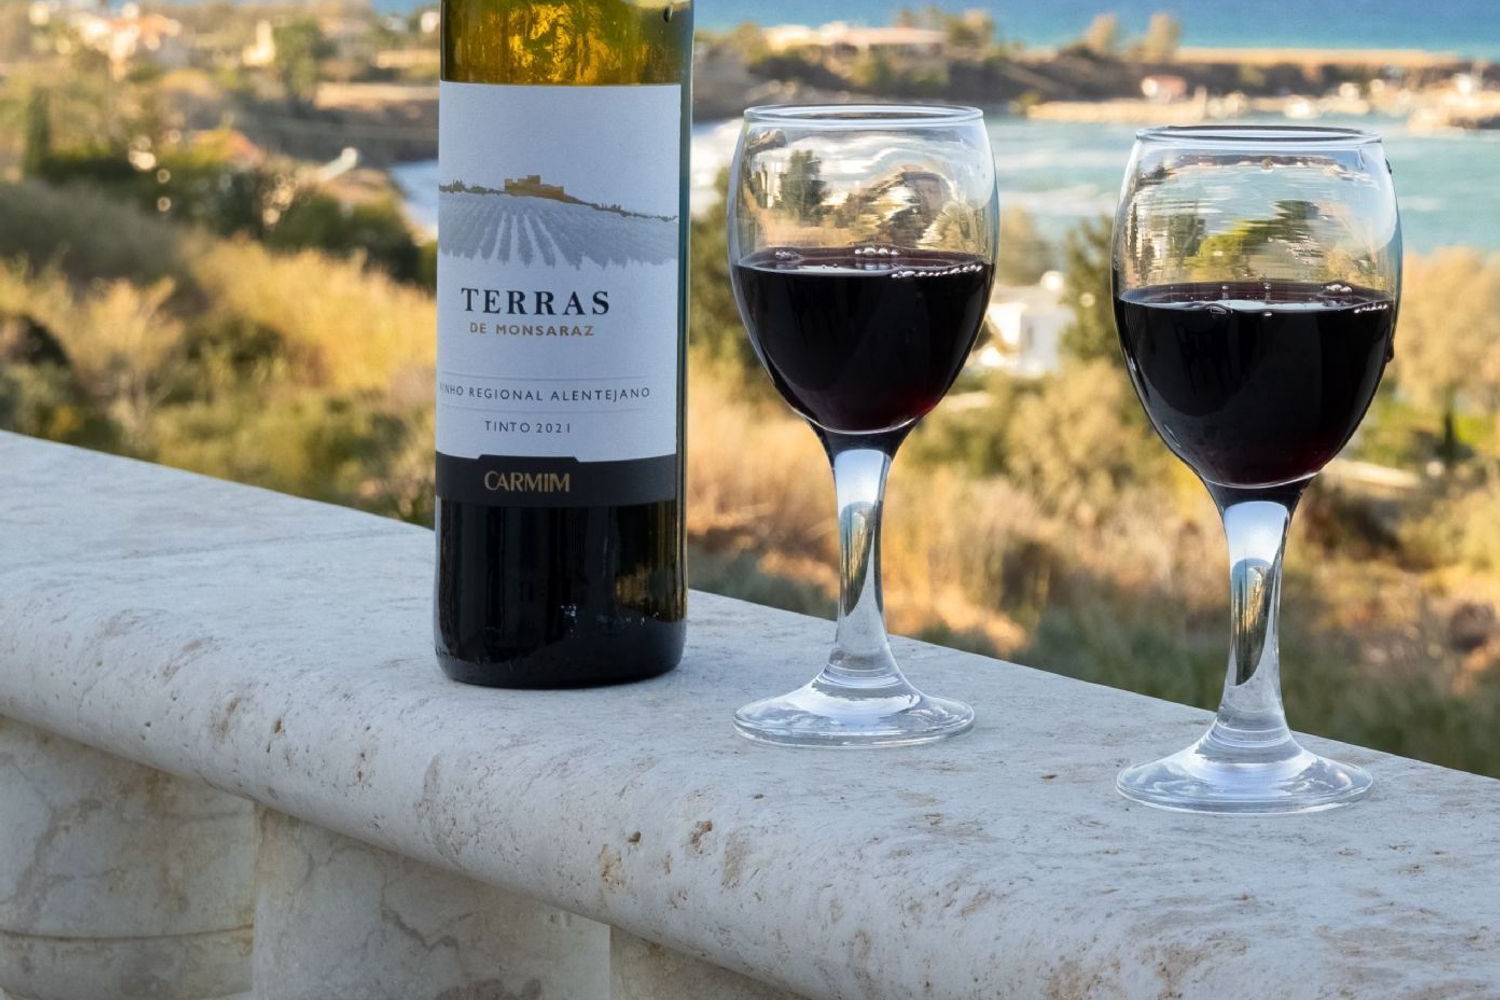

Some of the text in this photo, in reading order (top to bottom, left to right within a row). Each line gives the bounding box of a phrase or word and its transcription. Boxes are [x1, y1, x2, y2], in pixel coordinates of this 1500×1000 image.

[461, 287, 610, 316] TERRAS
[469, 321, 594, 337] DE MONSARAZ
[469, 387, 543, 401] REGIONAL
[550, 387, 650, 402] ALENTEJANO
[485, 420, 571, 433] TINTO 2021
[484, 470, 570, 493] CARMIM
